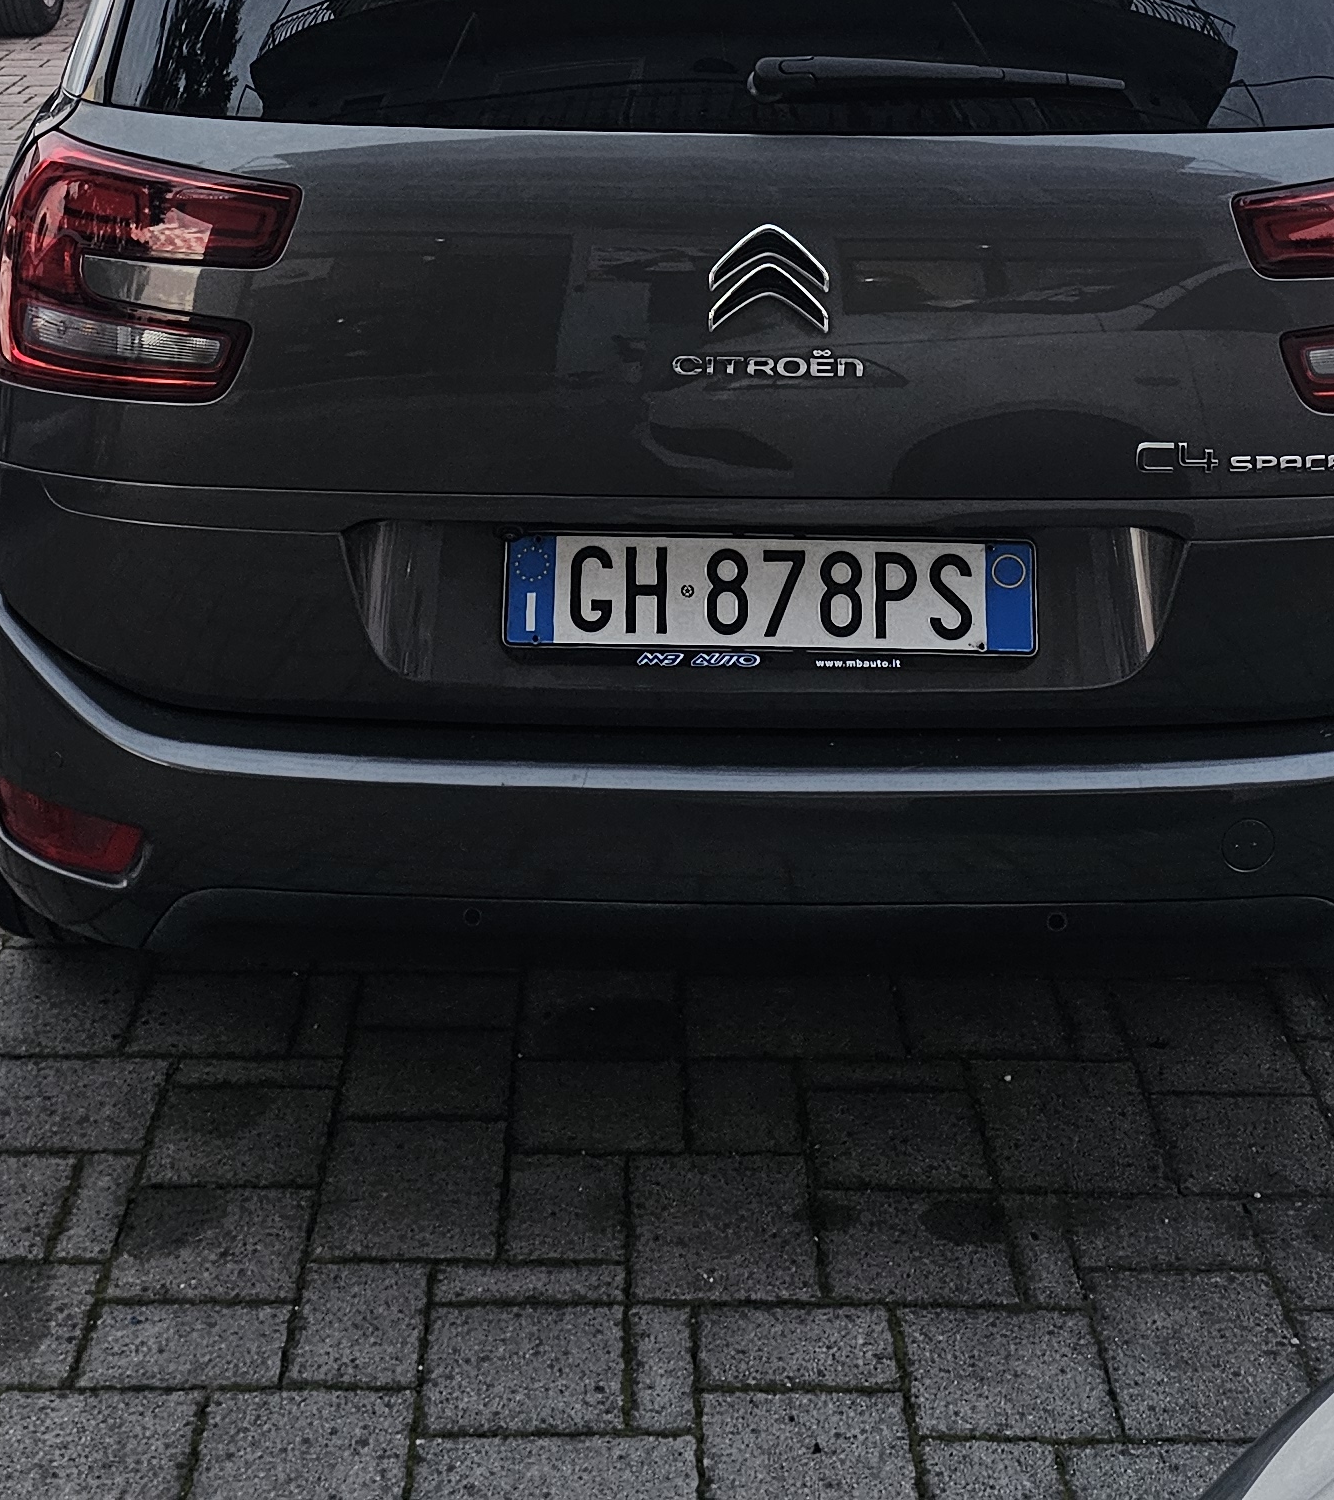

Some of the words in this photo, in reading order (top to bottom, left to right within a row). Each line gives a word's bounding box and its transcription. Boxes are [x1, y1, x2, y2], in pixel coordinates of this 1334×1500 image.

[1135, 441, 1219, 474] C4
[569, 544, 668, 635] GH
[704, 547, 974, 641] 878PS
[690, 653, 761, 668] AUTO
[815, 658, 902, 668] www.mbauto.it
